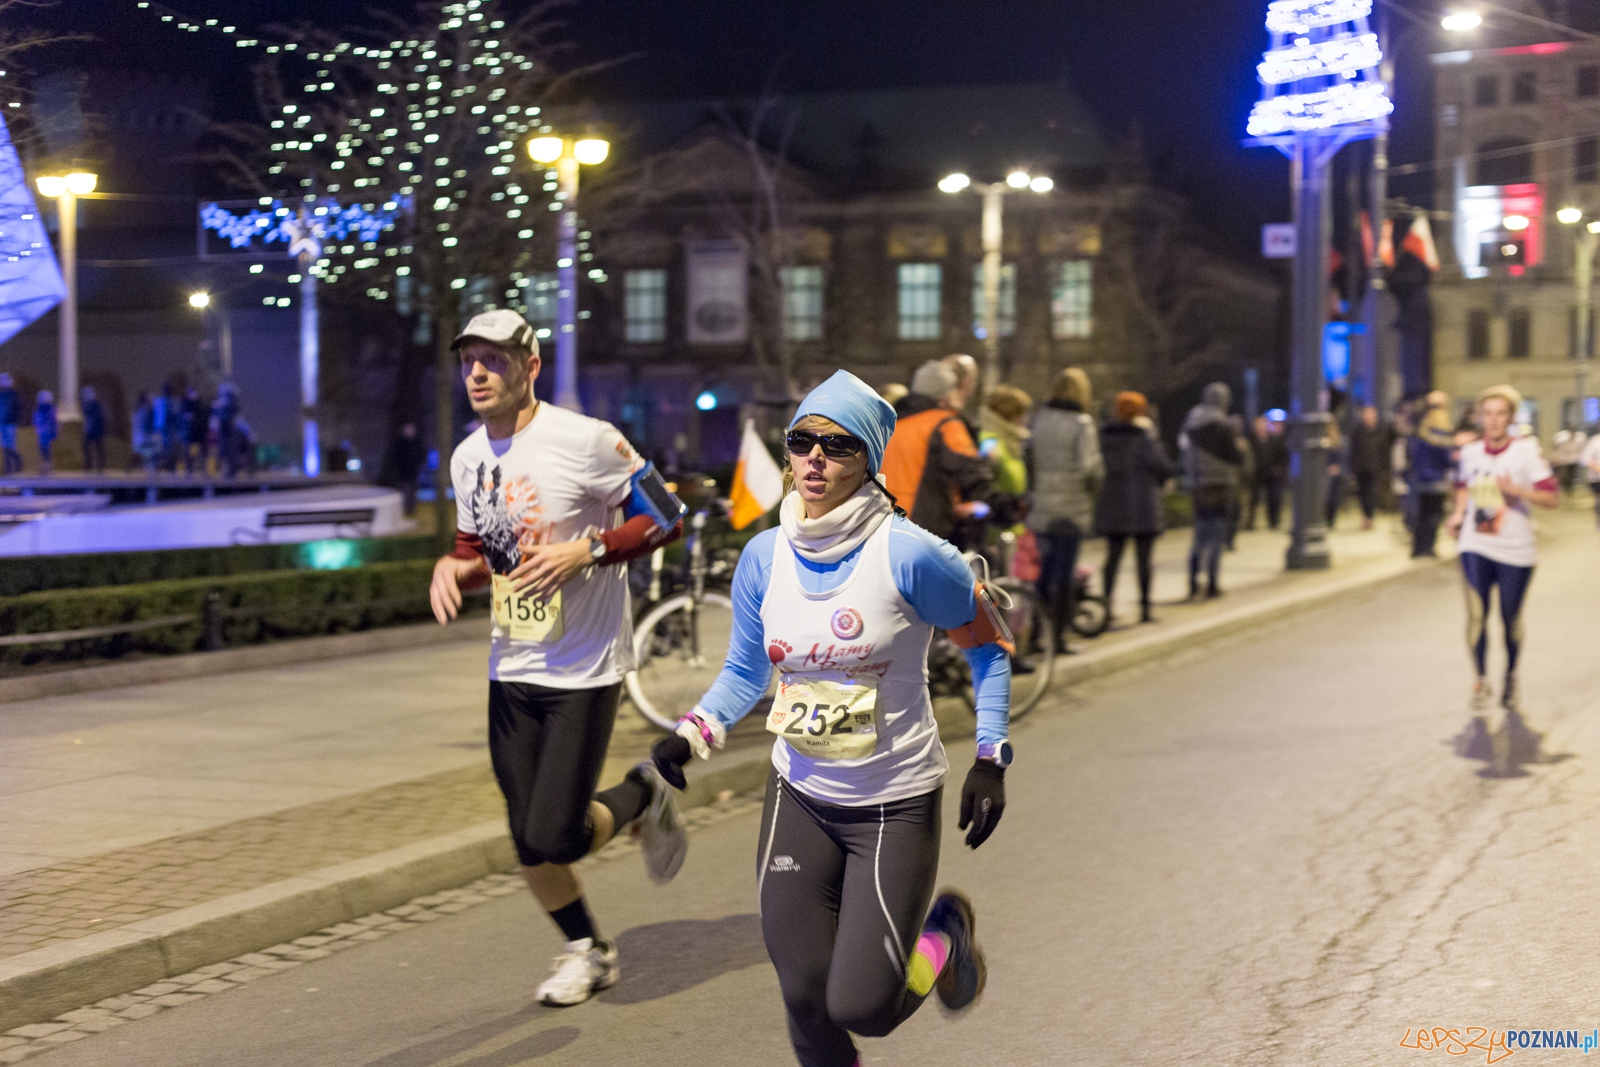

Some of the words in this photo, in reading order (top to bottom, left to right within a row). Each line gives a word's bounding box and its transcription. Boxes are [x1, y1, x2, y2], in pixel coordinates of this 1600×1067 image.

[504, 595, 546, 622] 158
[803, 642, 876, 667] Mamy
[783, 702, 853, 737] 252
